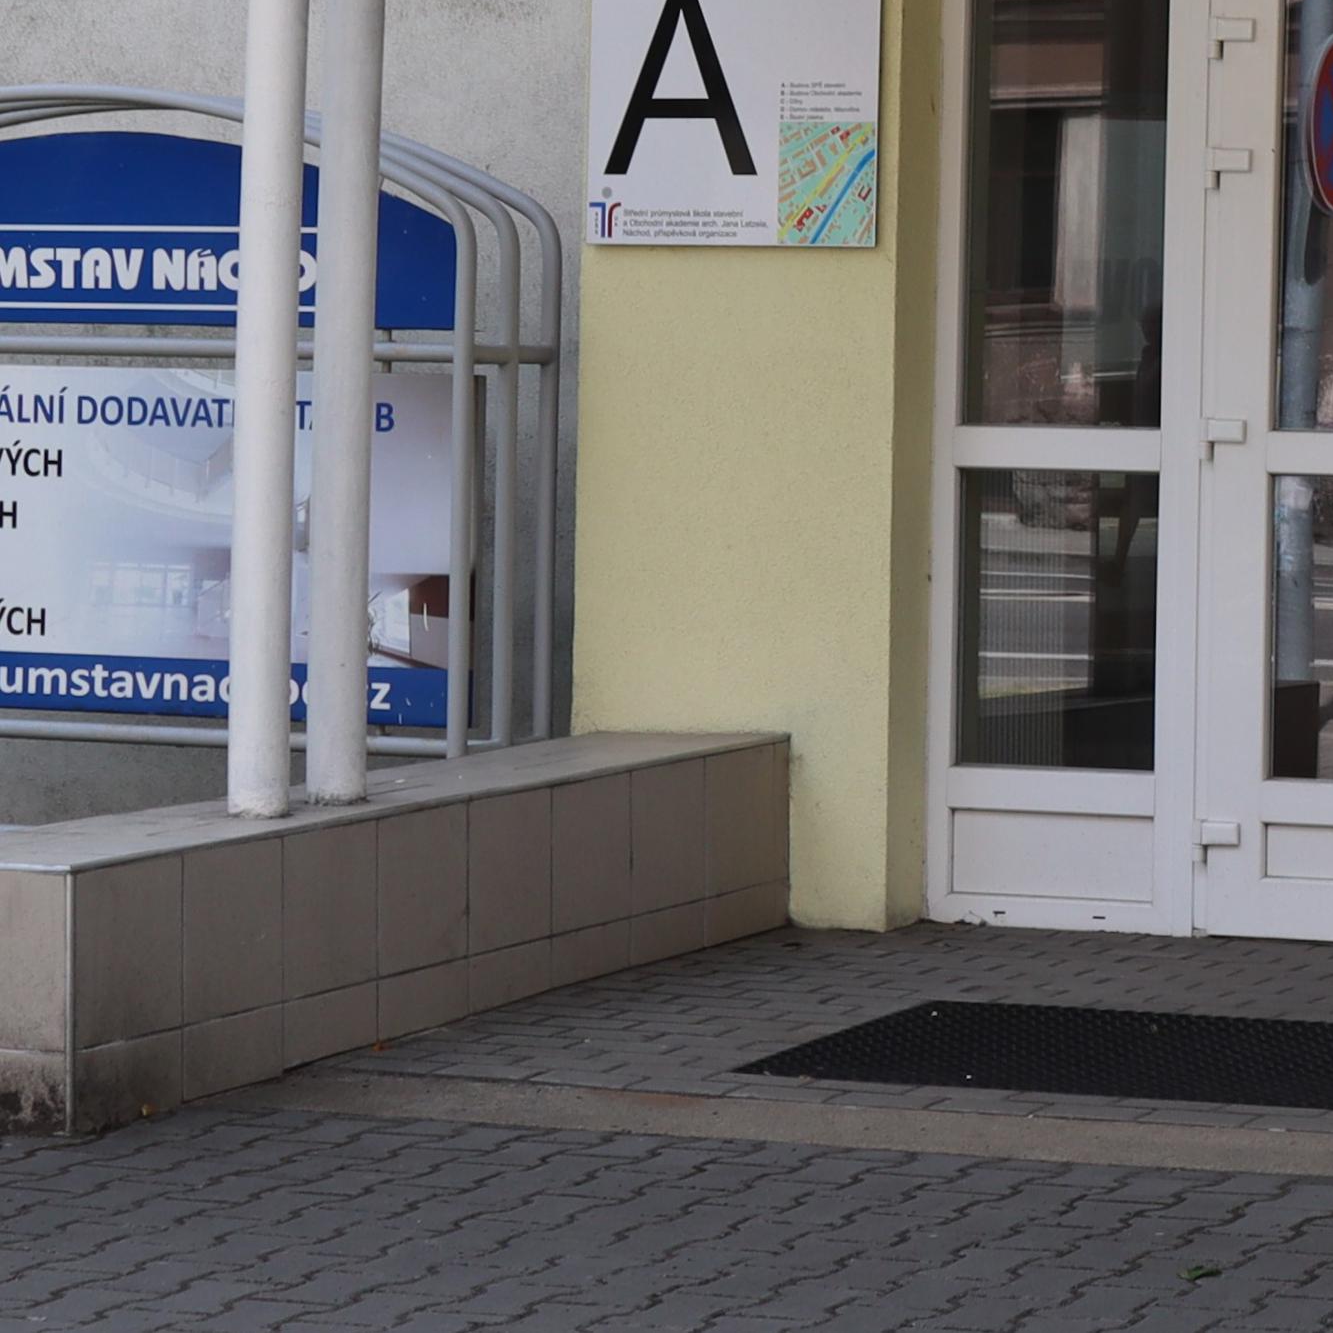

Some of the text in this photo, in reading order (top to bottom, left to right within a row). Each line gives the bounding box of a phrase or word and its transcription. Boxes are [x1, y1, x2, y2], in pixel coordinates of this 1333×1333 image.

[153, 248, 317, 292] NÁCO
[77, 395, 235, 429] DODAVAT
[0, 440, 63, 477] ÝCH
